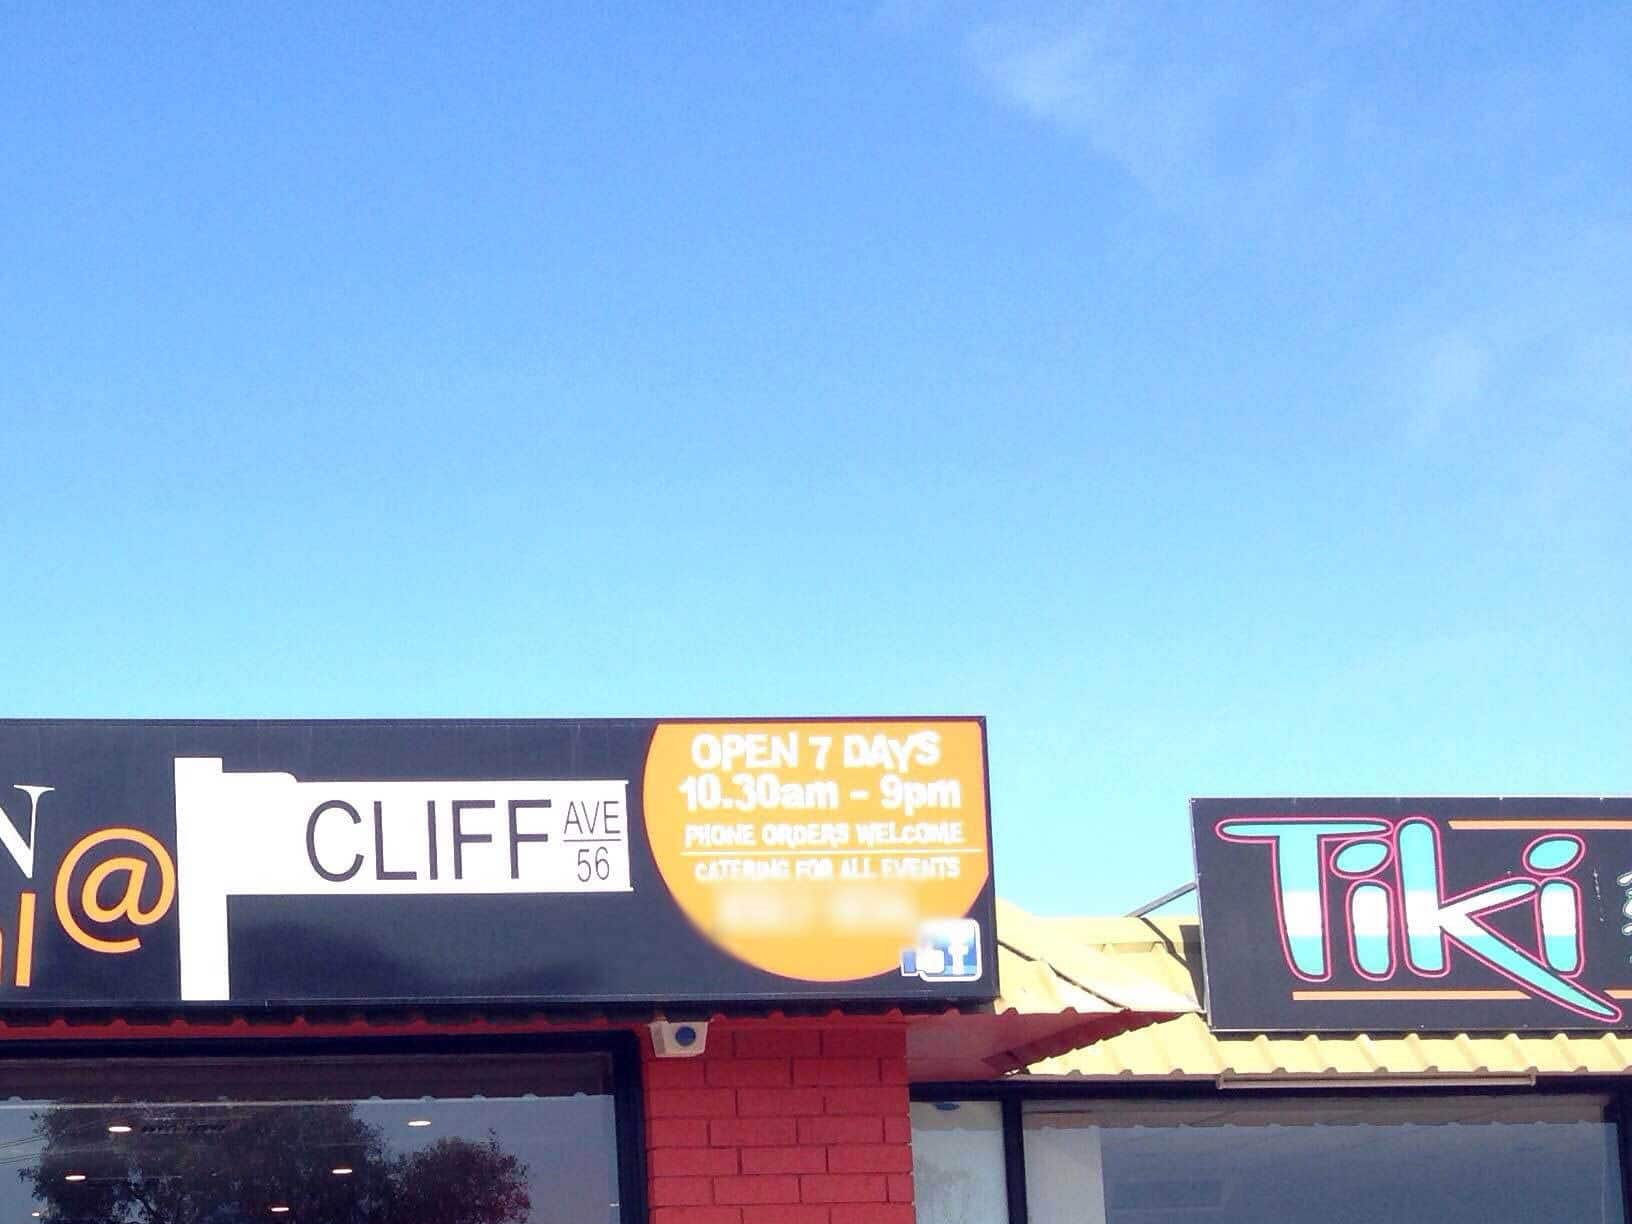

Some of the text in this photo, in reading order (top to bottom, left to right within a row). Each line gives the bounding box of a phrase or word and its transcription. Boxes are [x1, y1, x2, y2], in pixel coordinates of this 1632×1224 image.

[691, 731, 941, 771] OPEN 7 DAYS
[679, 773, 838, 812] 10.30am
[879, 774, 962, 815] 9pm
[306, 799, 621, 882] CLIFF AVE
[685, 821, 966, 848] PHONE ORDERS WELCOME
[577, 846, 610, 882] 56
[694, 856, 961, 882] CATERING FOR ALL EVENTS
[53, 827, 176, 954] @
[1216, 815, 1622, 1023] Tiki
